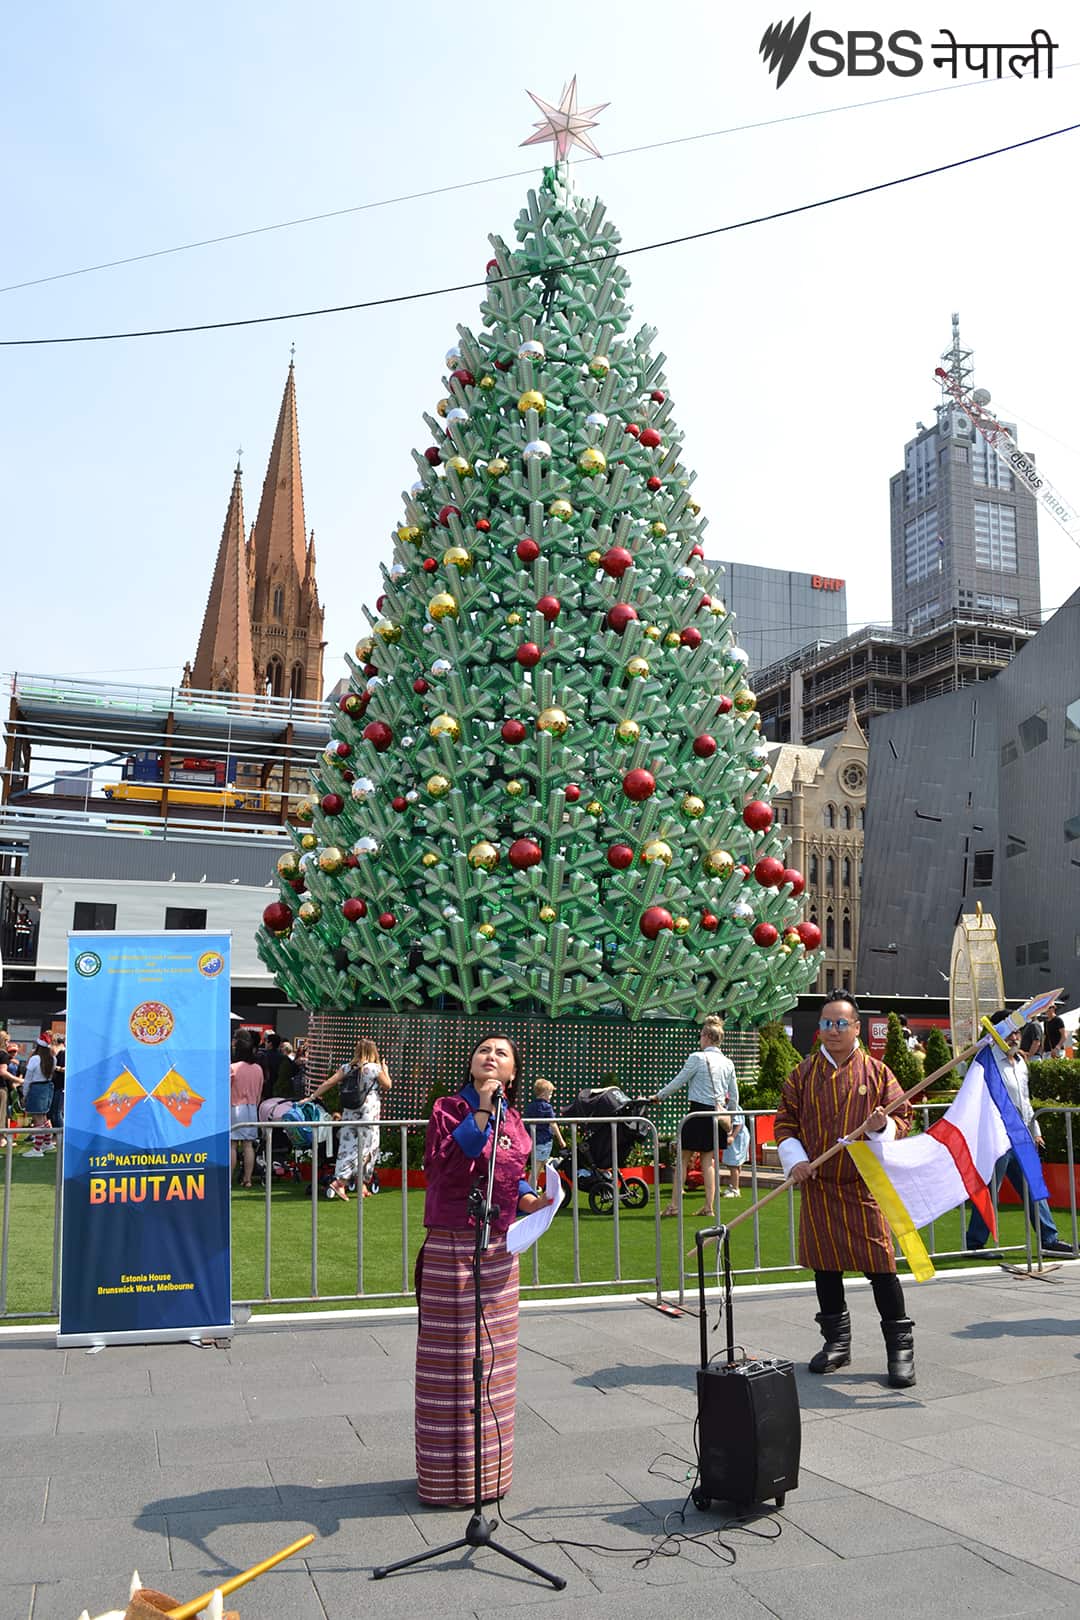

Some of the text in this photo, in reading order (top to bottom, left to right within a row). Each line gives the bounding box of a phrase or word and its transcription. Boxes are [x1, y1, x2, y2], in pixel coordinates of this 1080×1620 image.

[1010, 452, 1043, 488] dexus
[812, 575, 845, 592] BHP
[89, 1152, 208, 1167] 112th NATIONAL DAY OF
[90, 1174, 205, 1204] BHUTAN
[121, 1273, 171, 1283] Estonia House
[97, 1282, 194, 1295] Brunswick West, Melbourne
